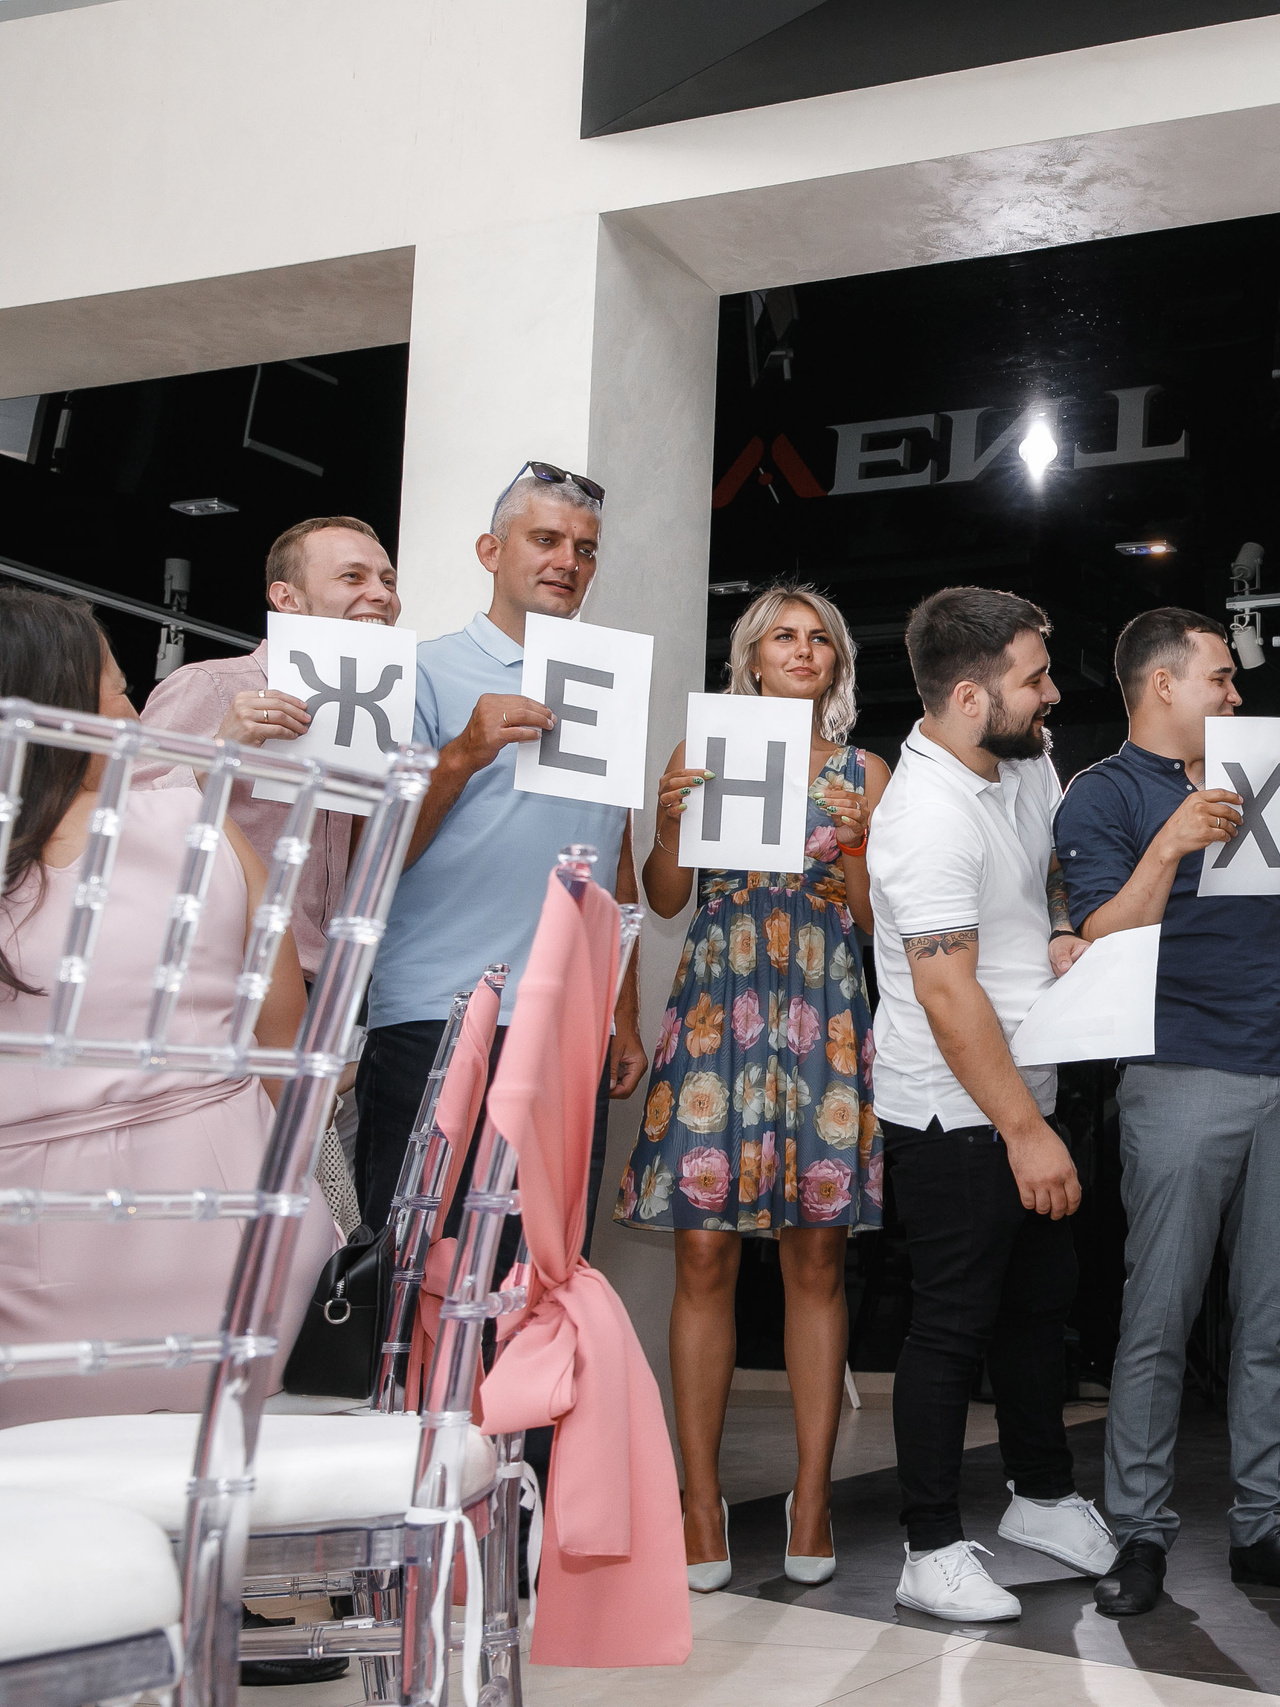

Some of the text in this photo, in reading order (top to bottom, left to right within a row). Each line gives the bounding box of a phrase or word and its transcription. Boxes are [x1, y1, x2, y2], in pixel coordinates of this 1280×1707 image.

[288, 649, 403, 755] Ж
[538, 658, 615, 777] Е
[700, 736, 790, 845] Н
